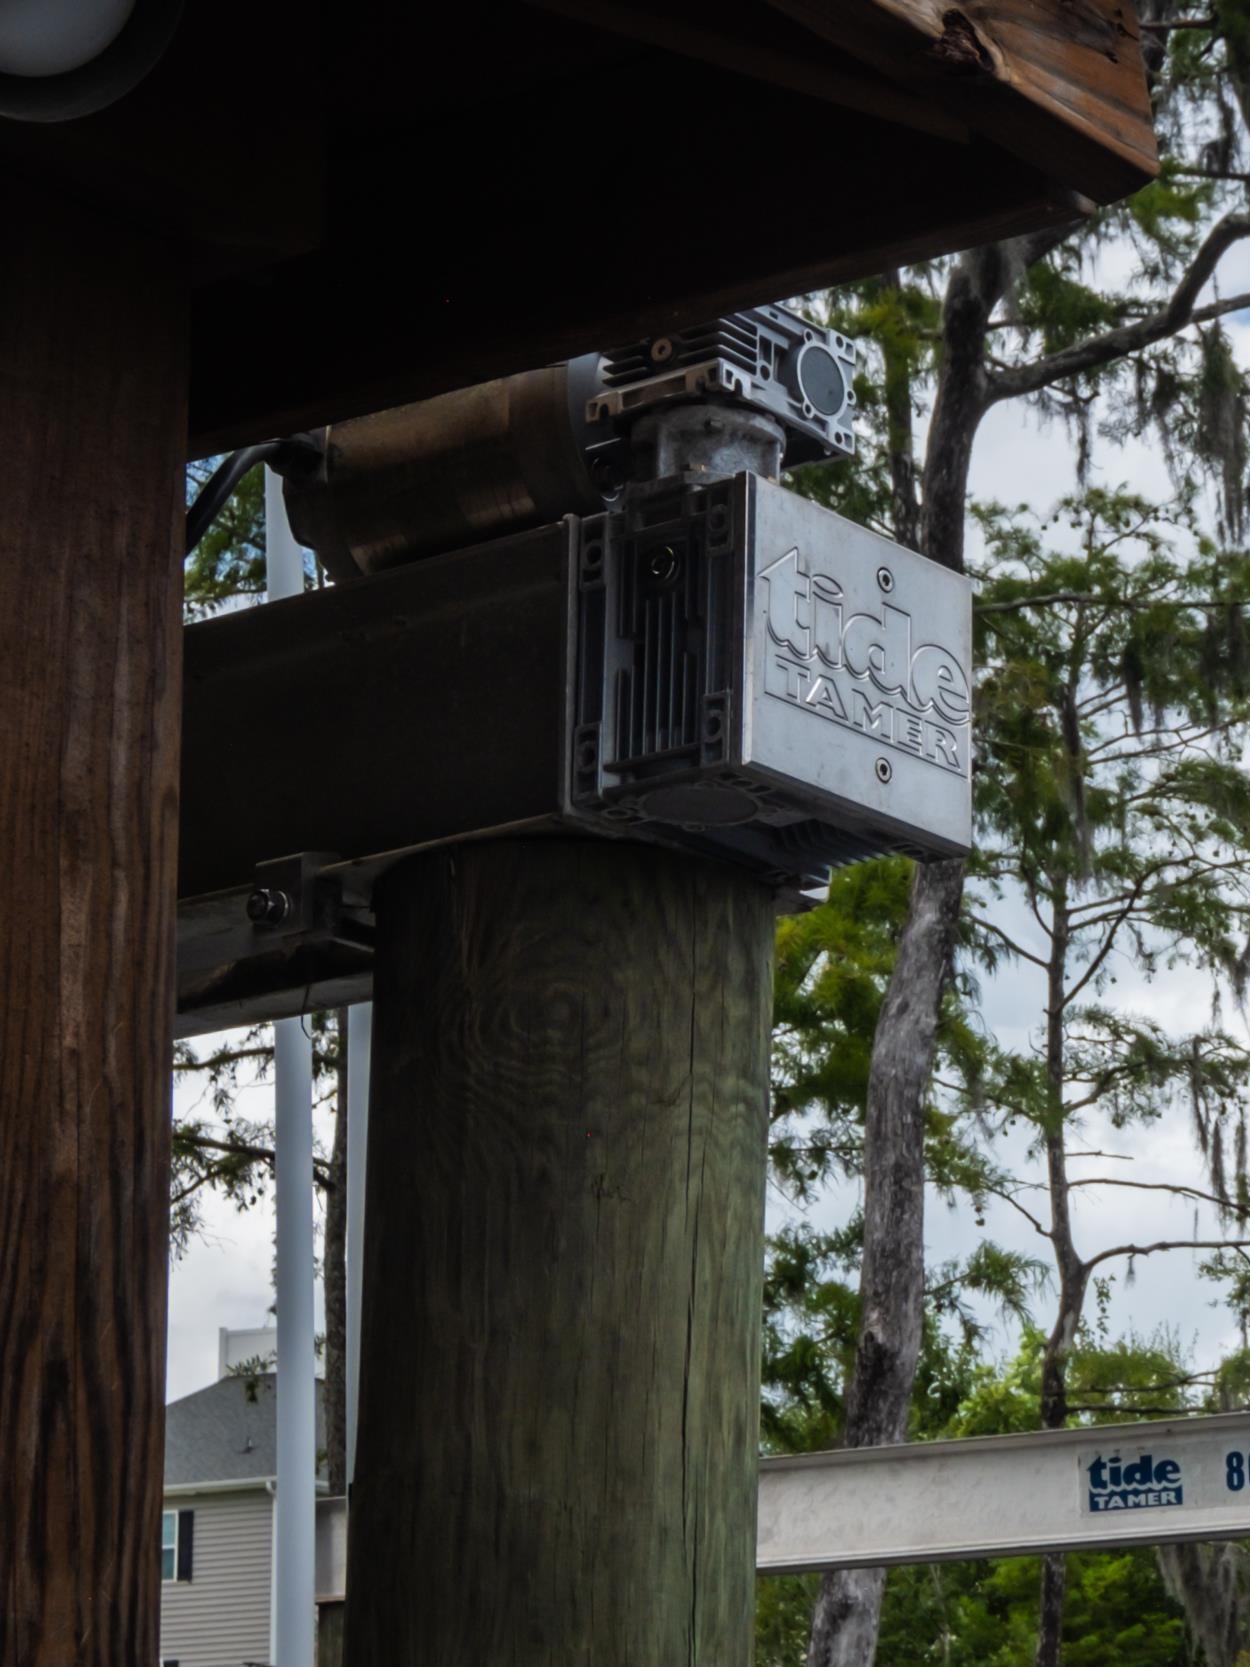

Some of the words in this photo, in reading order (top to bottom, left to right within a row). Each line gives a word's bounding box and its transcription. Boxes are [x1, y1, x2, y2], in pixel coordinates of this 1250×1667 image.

[756, 547, 970, 726] tide
[774, 653, 961, 771] TAMER
[1087, 1454, 1182, 1490] tide
[1093, 1490, 1178, 1510] TAMER
